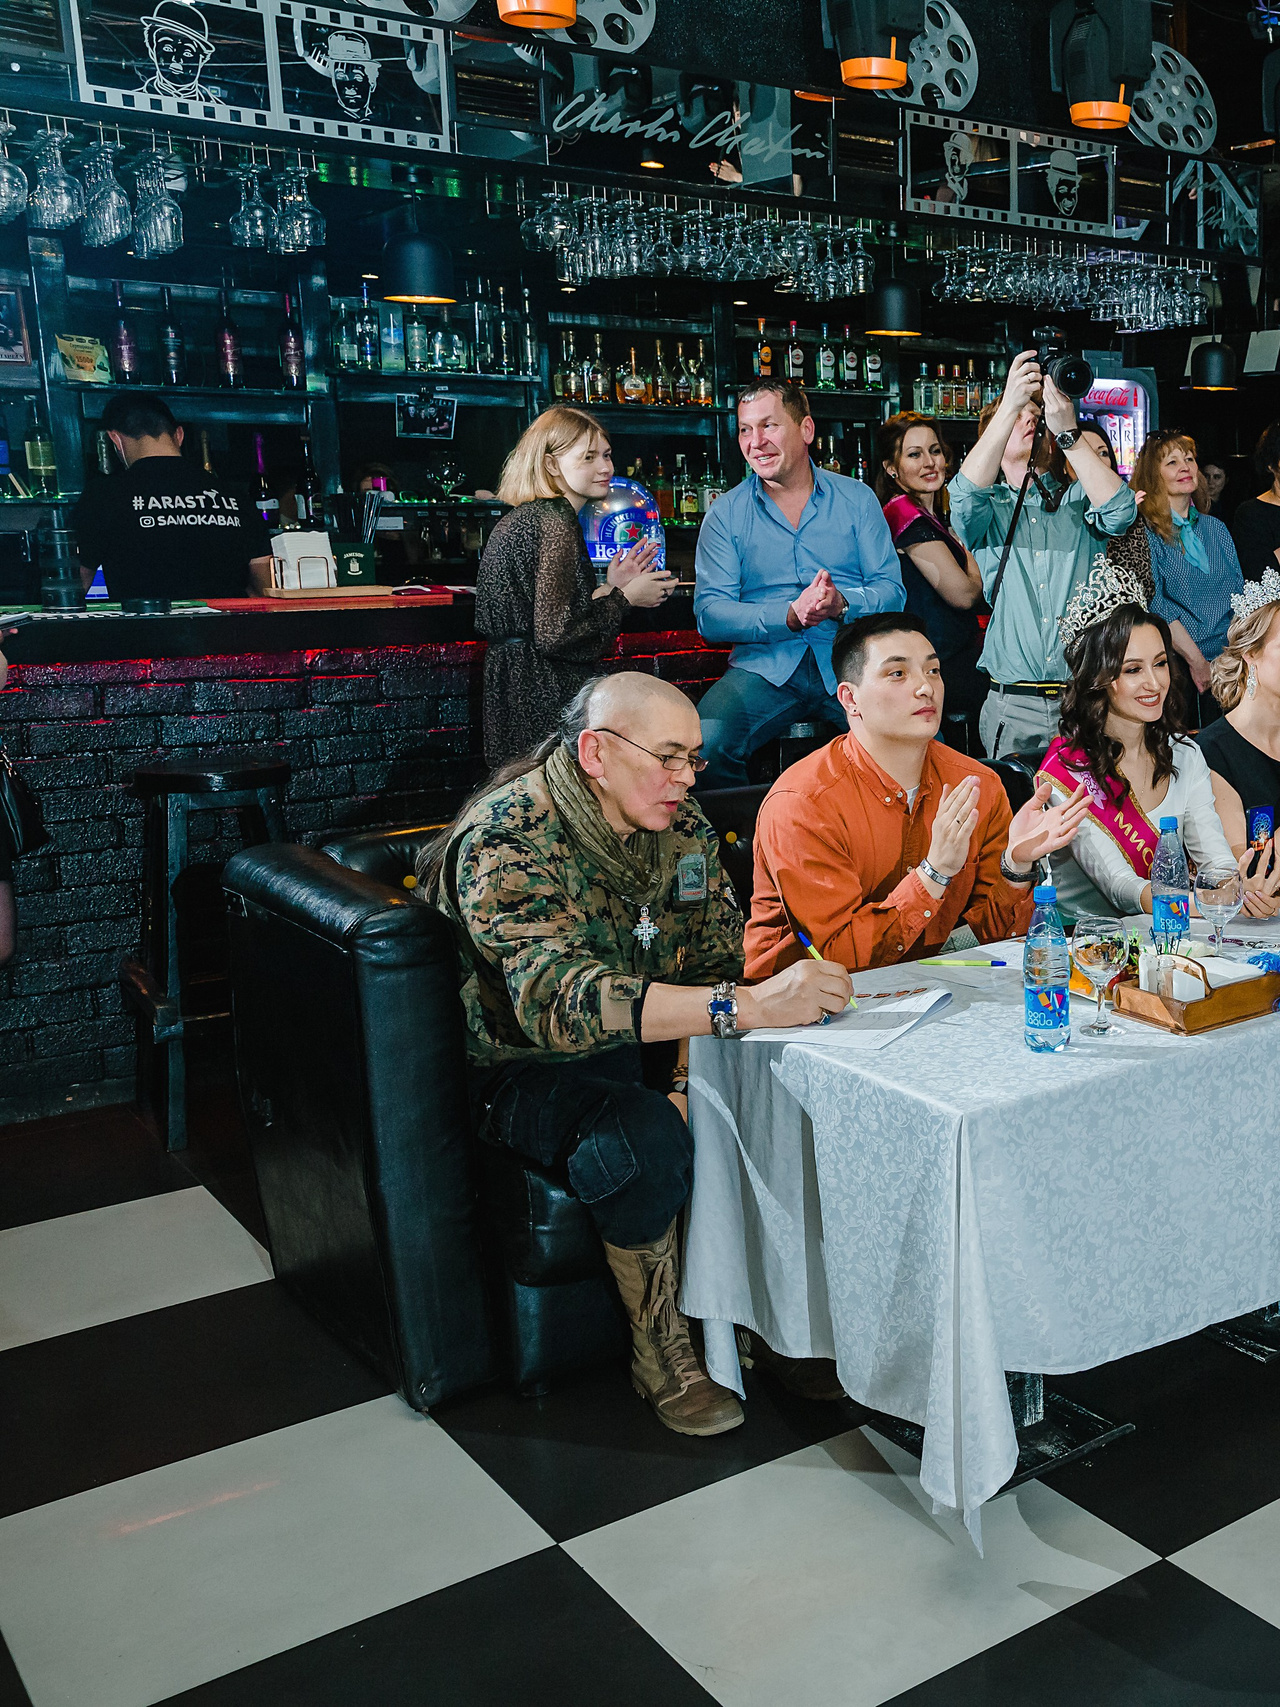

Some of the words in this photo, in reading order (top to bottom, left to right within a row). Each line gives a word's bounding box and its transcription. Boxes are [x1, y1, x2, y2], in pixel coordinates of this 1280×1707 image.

[157, 514, 241, 527] SAMOKABAR
[605, 512, 636, 538] HEINEKEN
[1027, 1009, 1046, 1018] bon
[1028, 1017, 1053, 1027] aqua
